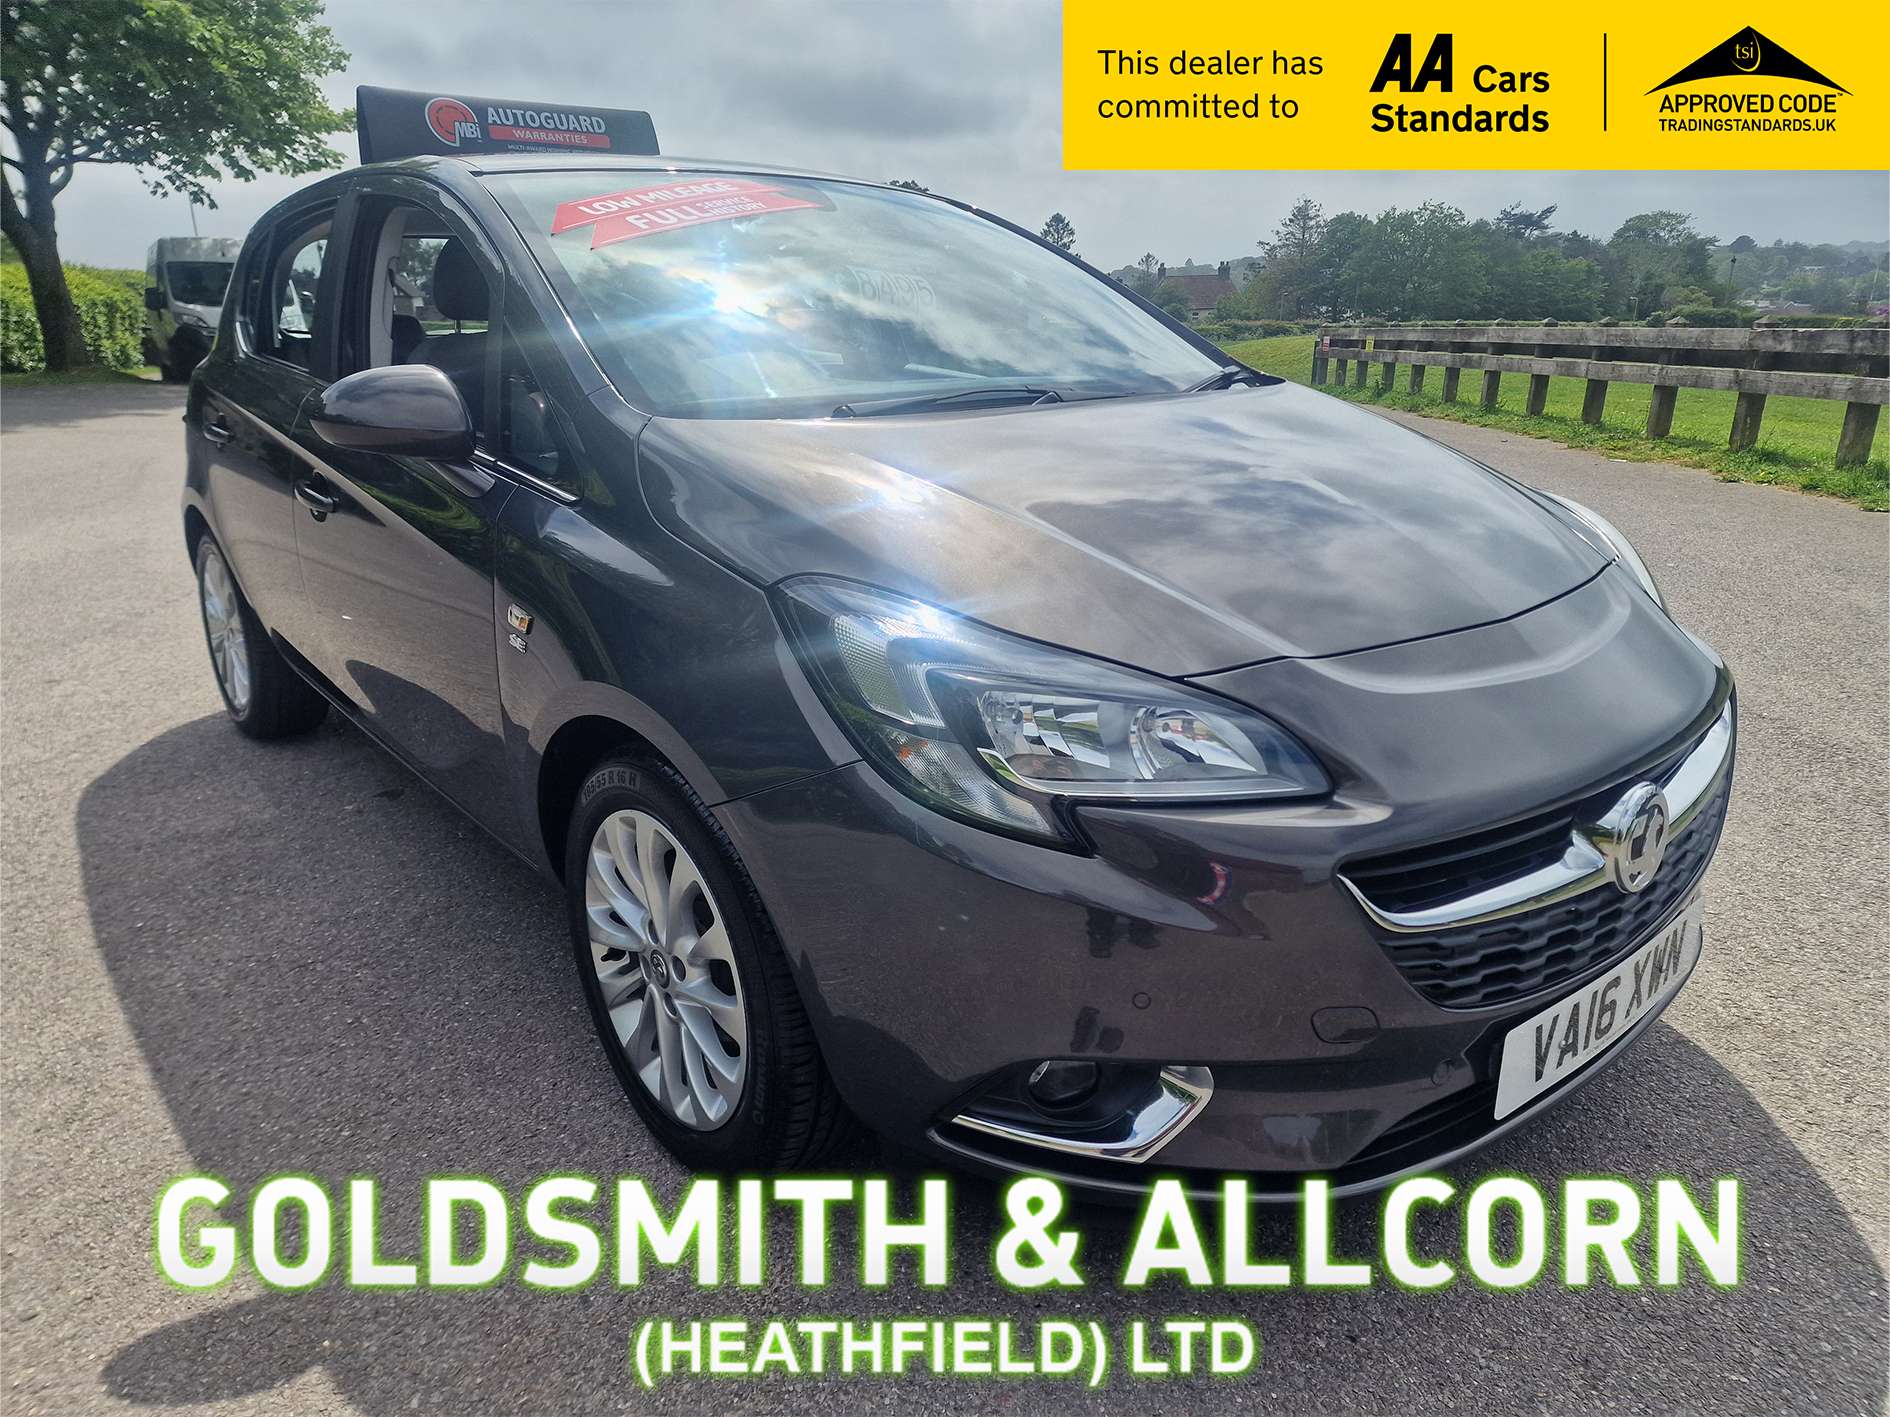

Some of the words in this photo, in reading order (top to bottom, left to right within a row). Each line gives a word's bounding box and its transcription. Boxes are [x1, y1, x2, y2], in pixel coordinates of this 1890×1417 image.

[487, 106, 606, 134] AUTOGUARD
[512, 128, 588, 144] WARRANTIES
[577, 196, 642, 215] LOW
[635, 182, 739, 204] MILEAGE
[625, 205, 713, 229] FULL
[1535, 975, 1622, 1083] VA16
